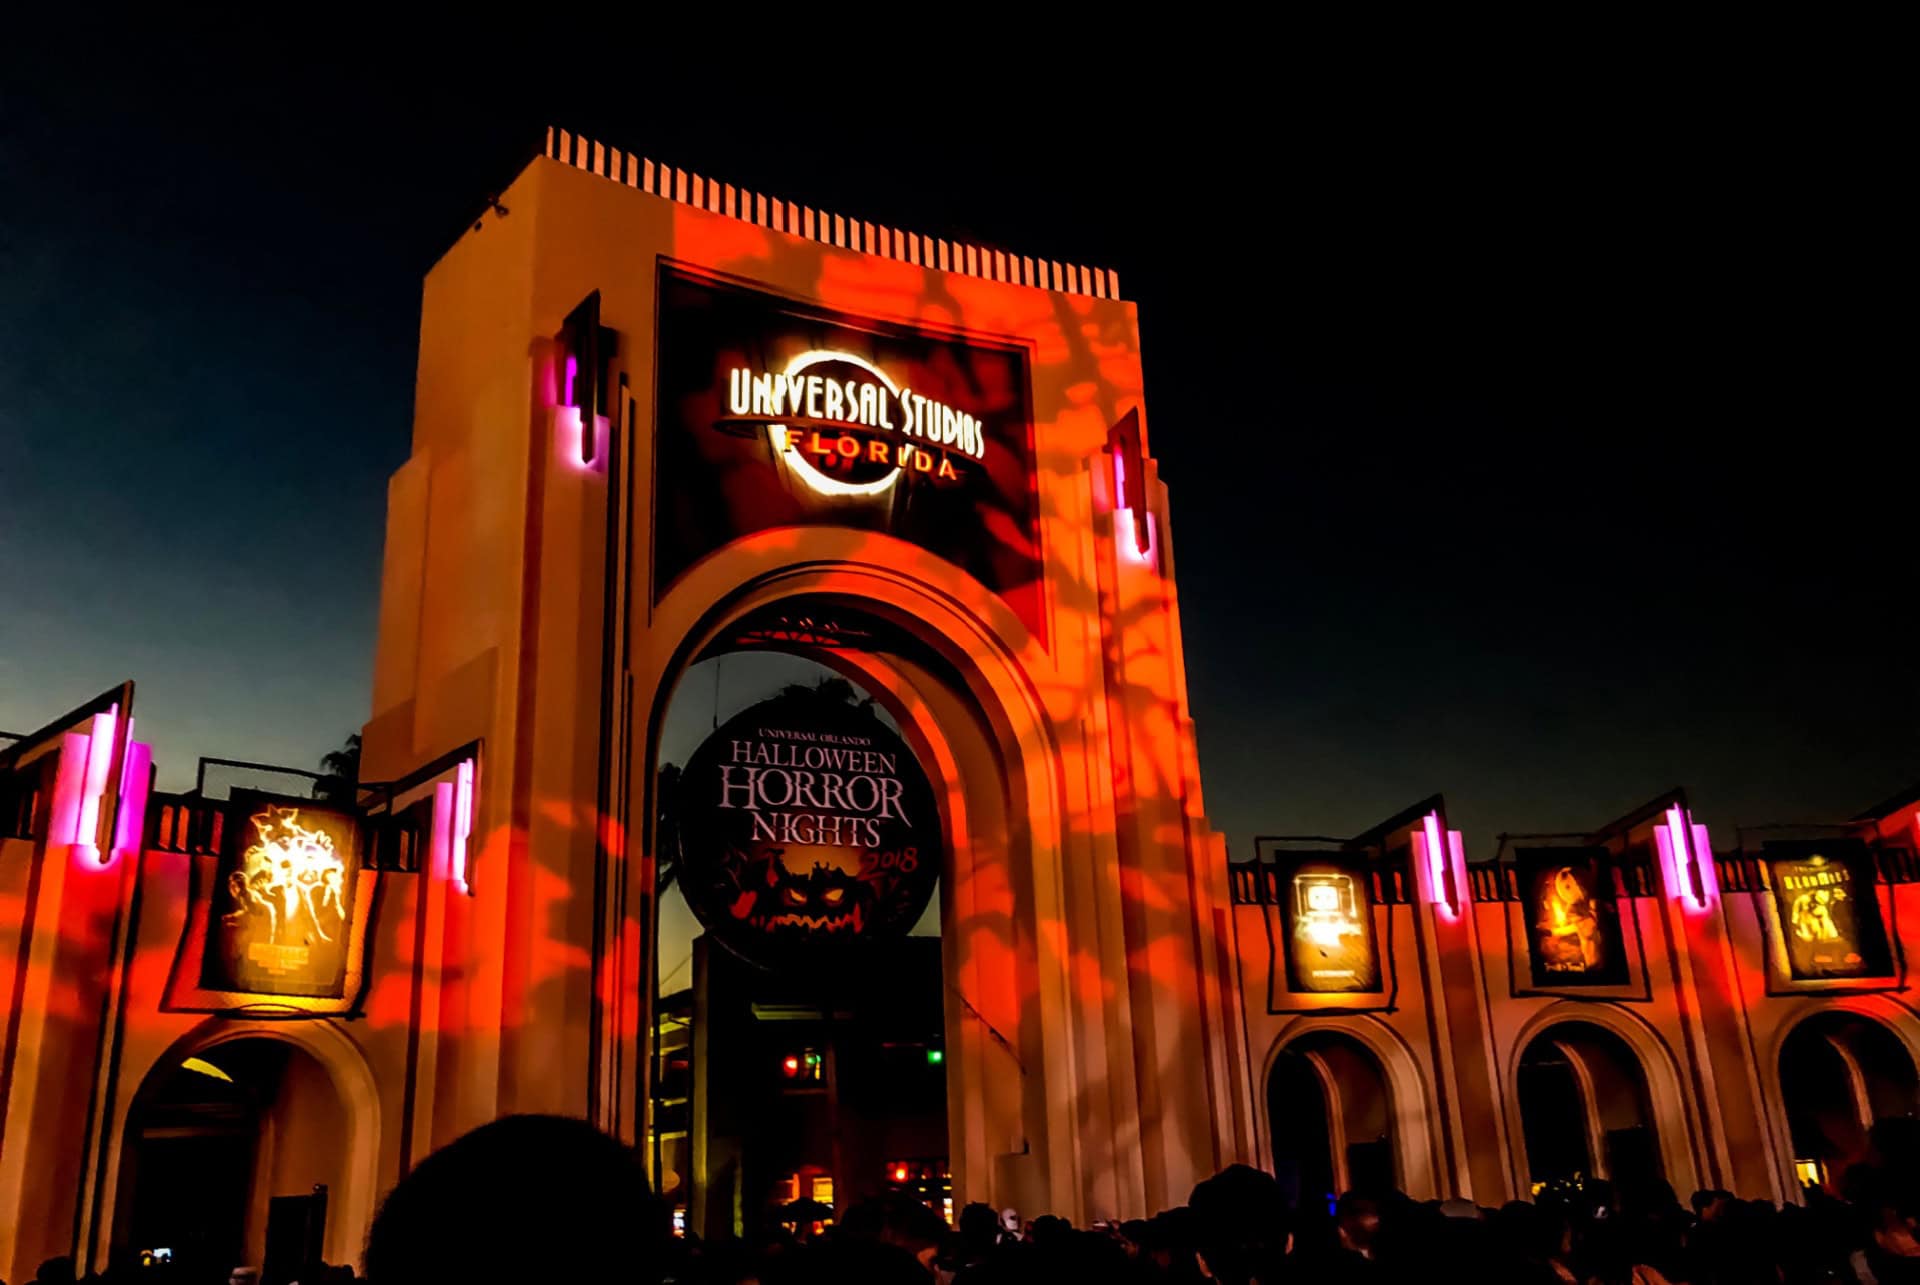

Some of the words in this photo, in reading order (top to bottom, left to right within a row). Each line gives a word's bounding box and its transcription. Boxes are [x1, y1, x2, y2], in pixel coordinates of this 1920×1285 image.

[730, 368, 894, 430] UNIVERSAL
[901, 388, 985, 459] STUDIOS
[784, 430, 957, 481] FLORIDA
[758, 728, 816, 742] UNIVERSAL
[820, 734, 872, 746] ORLANDO
[731, 740, 897, 775] HALLOWEEN
[717, 765, 912, 828] HORROR
[751, 811, 881, 848] NIGHTS
[857, 847, 919, 880] 2018
